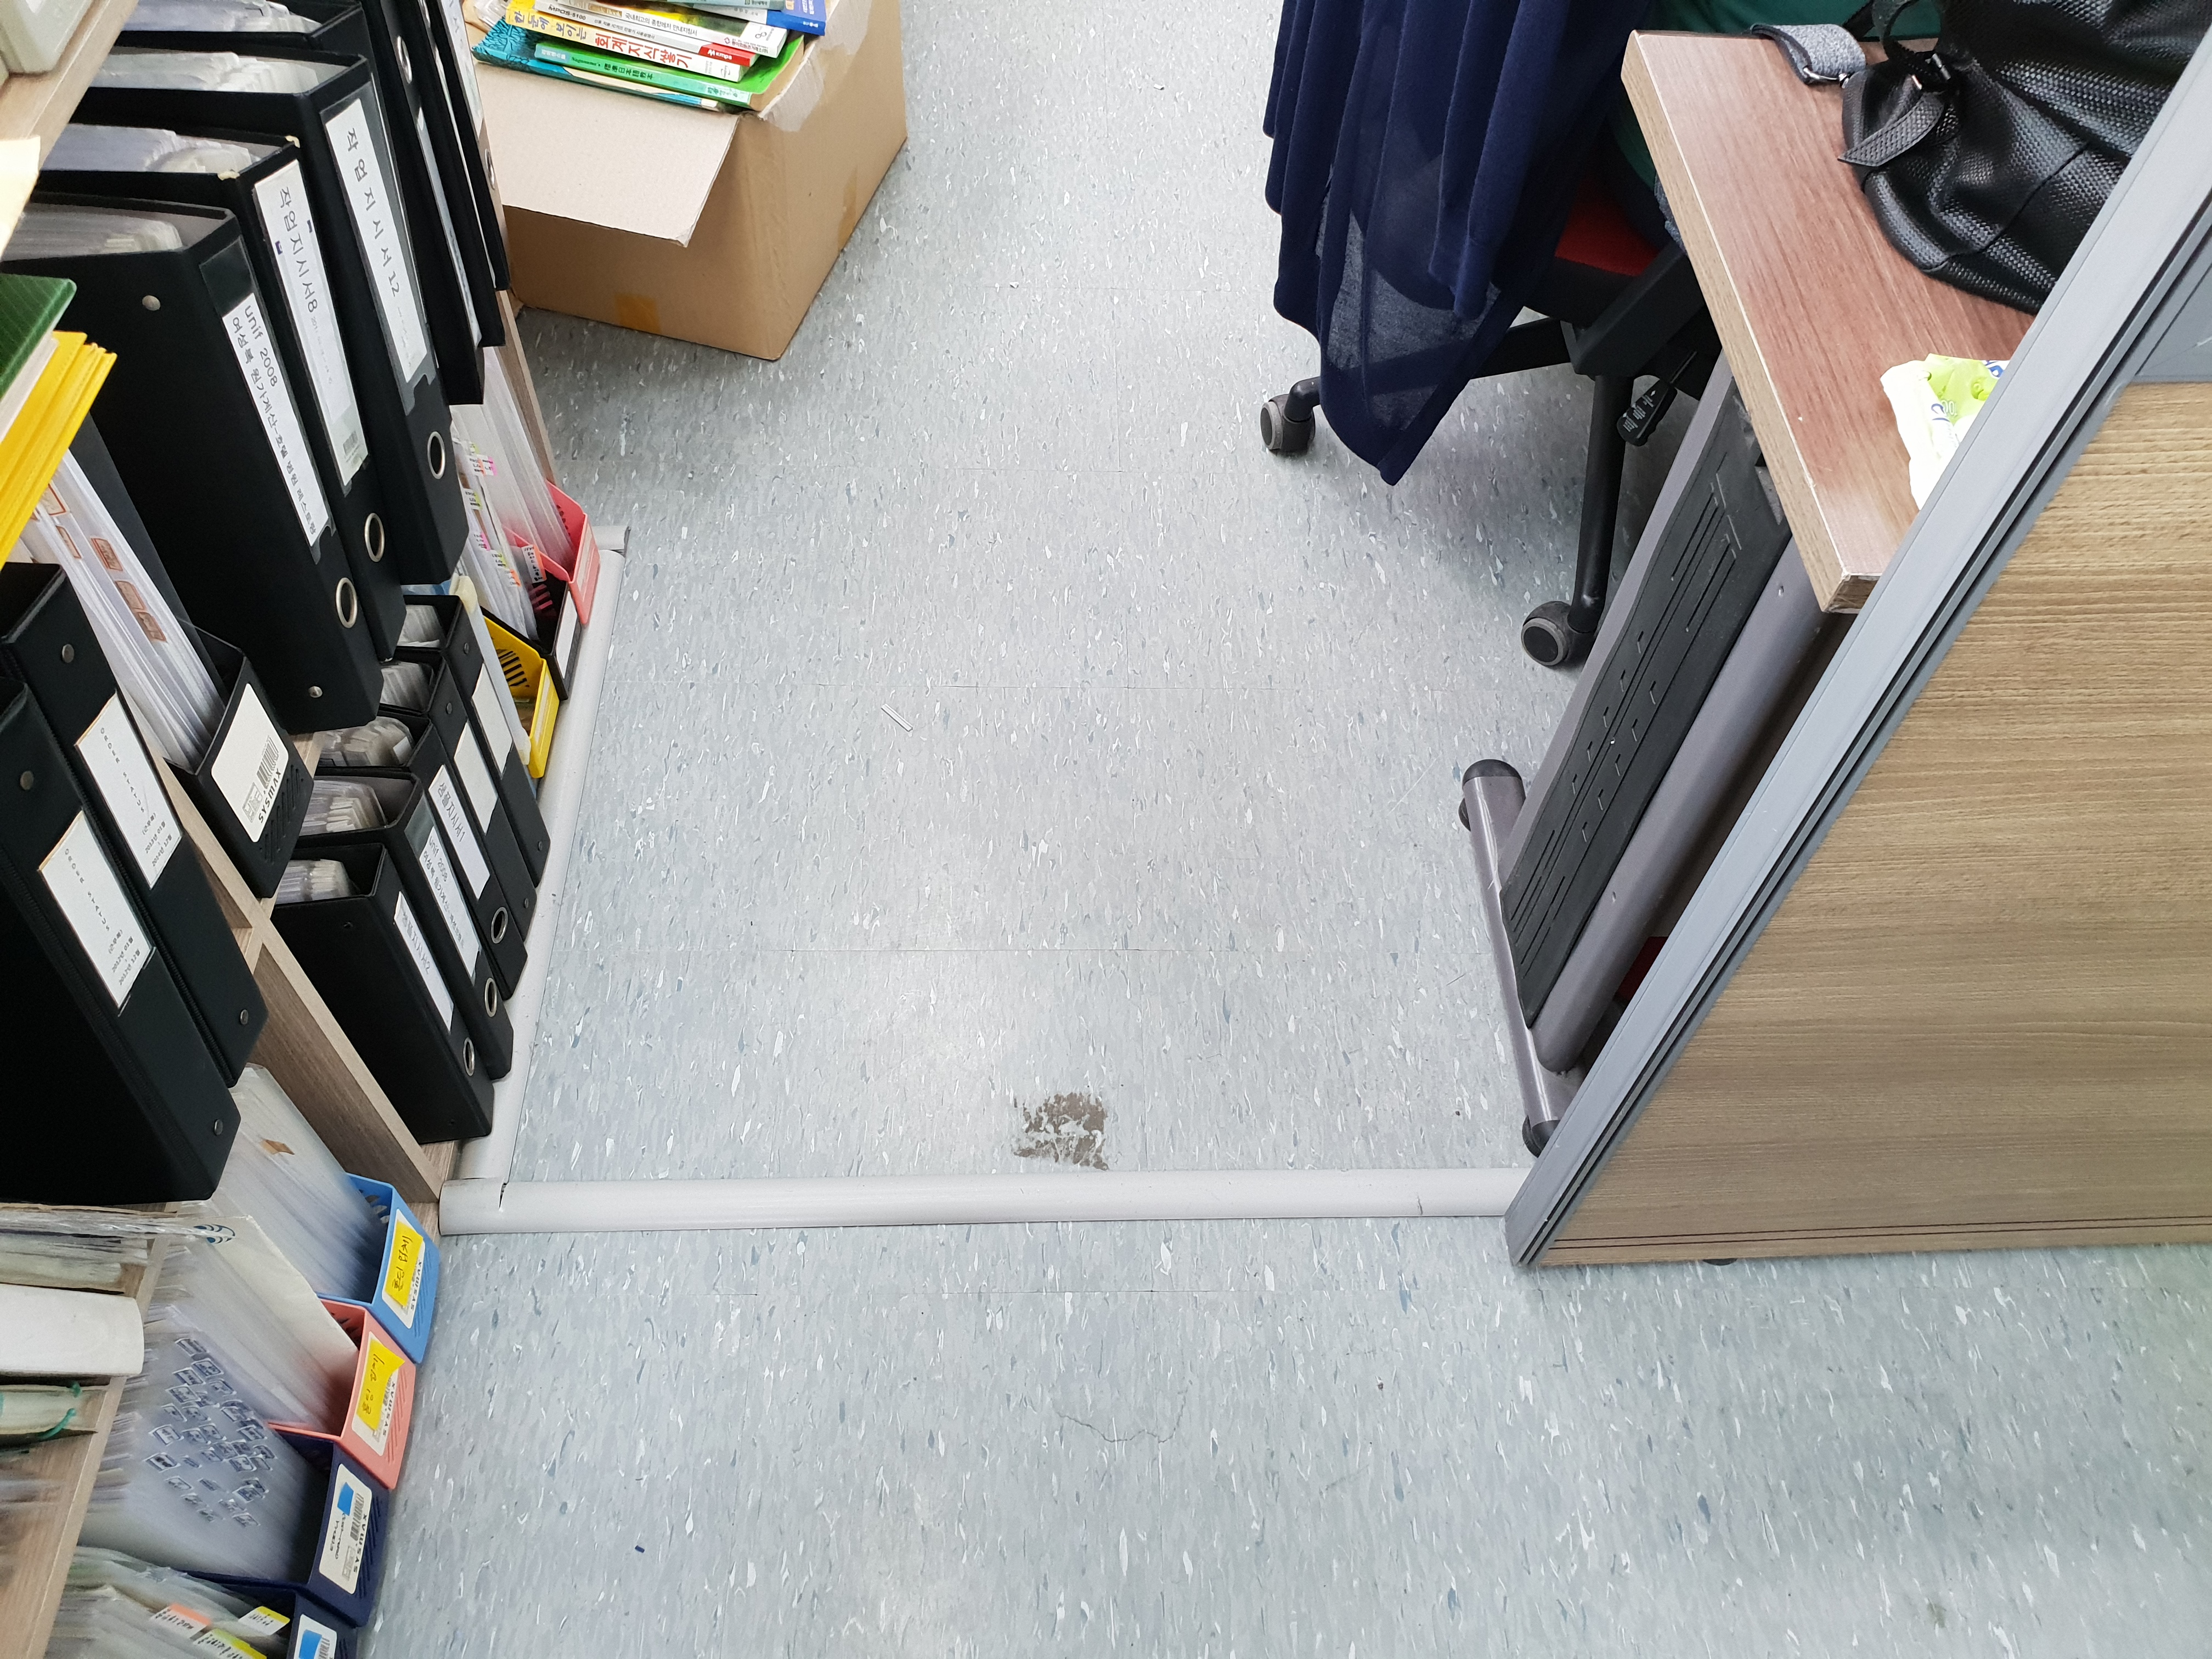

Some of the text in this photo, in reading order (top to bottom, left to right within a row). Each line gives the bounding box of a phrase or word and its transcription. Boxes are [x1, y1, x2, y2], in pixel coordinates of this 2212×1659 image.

[556, 21, 588, 41] 보이는
[595, 33, 692, 69] 회계지식쌓기
[245, 305, 278, 387] unif 2008
[100, 727, 144, 813] ORDER STATUS
[429, 835, 439, 858] unif
[65, 848, 110, 932] ORDER STATUS
